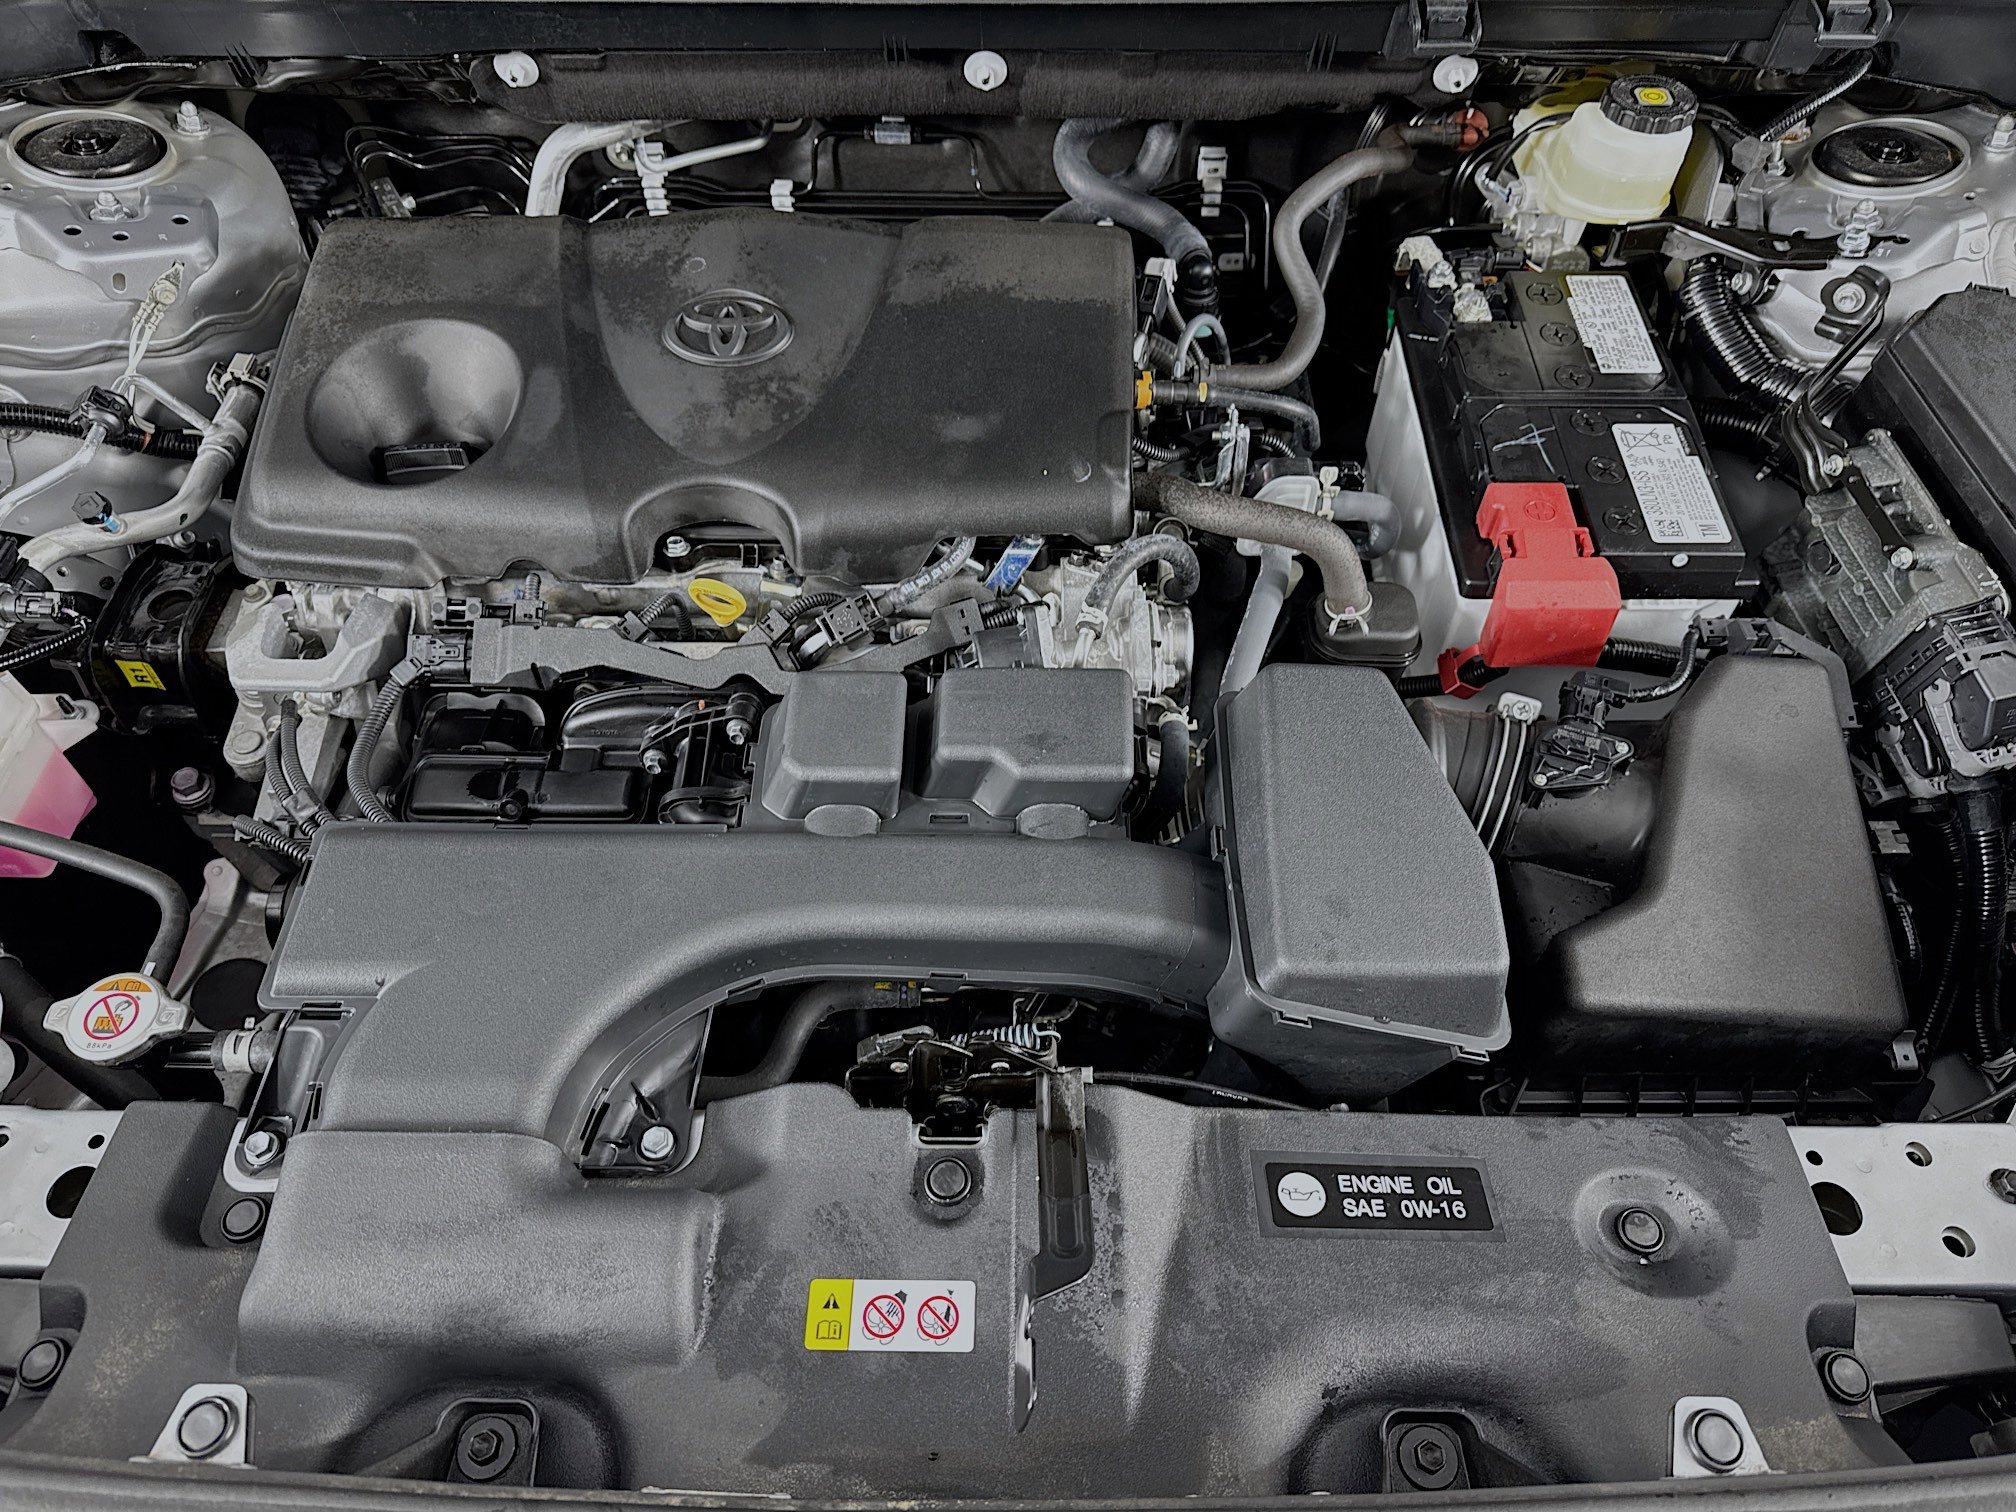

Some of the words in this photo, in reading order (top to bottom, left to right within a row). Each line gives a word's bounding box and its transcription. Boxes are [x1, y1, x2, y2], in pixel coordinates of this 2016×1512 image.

[1662, 434, 1673, 445] Pb
[1698, 524, 1721, 537] TM
[129, 668, 151, 683] R1
[1337, 1174, 1414, 1195] ENGINE
[1426, 1176, 1462, 1195] OIL
[1343, 1198, 1387, 1218] SAE
[1400, 1200, 1467, 1219] 0W-16
